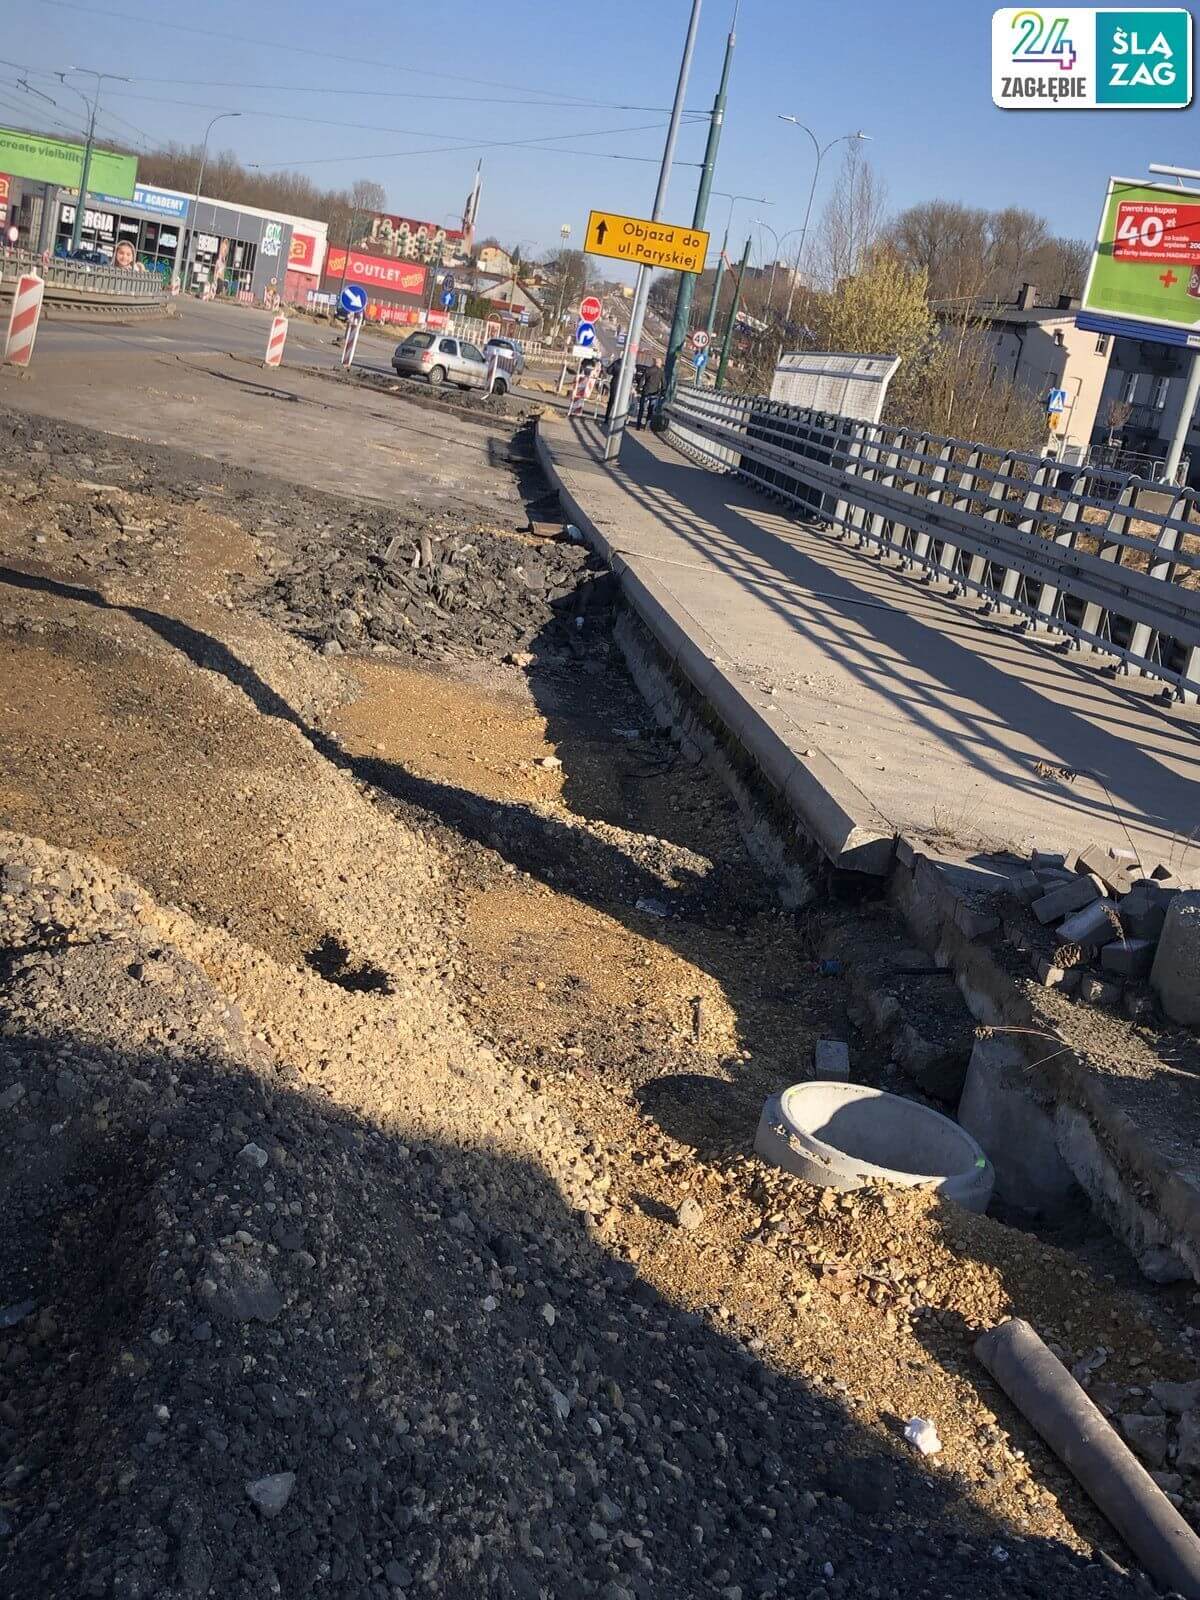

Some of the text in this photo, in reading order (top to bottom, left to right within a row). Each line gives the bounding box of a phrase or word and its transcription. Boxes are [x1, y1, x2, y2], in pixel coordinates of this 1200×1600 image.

[0, 139, 36, 154] create
[61, 205, 115, 232] ENRGIA
[1121, 205, 1177, 215] zwrot na kupon
[623, 222, 701, 249] Objazd do
[1117, 215, 1177, 248] 40 zł
[352, 261, 401, 282] OUTLET
[582, 305, 599, 315] STOP
[694, 335, 707, 344] 40
